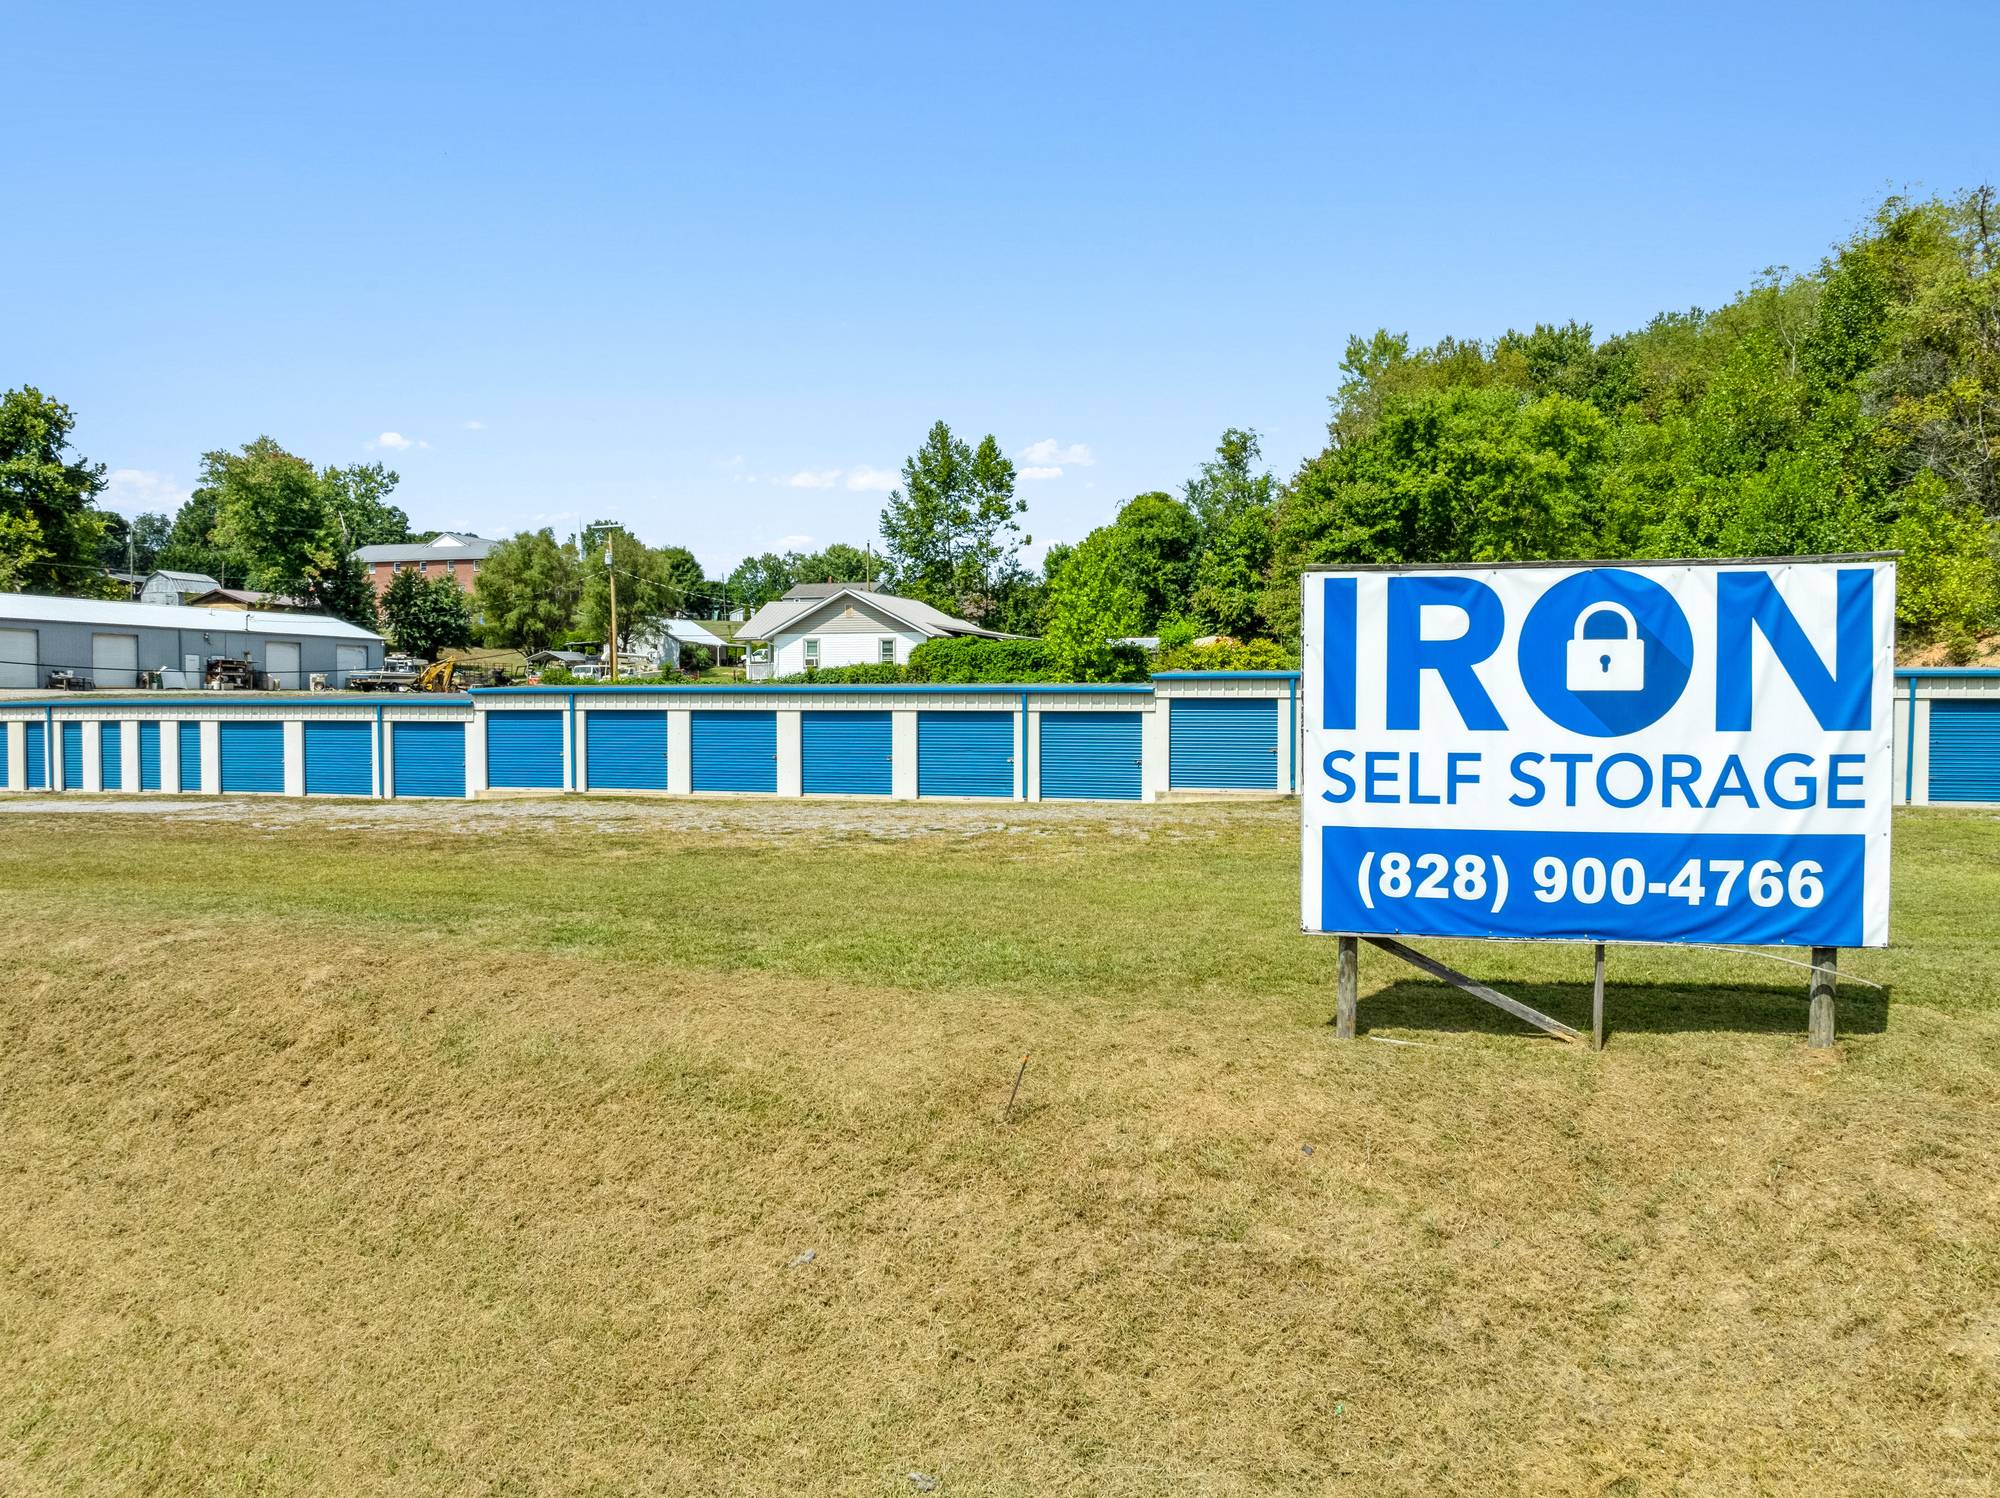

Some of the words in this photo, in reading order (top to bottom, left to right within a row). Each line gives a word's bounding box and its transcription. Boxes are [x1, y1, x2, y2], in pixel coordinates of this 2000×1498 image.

[1323, 568, 1875, 738] IRON
[1321, 750, 1482, 804] SELF
[1508, 752, 1866, 809] STORAGE
[1358, 851, 1509, 912] (828)
[1533, 856, 1824, 908] 900-4766
